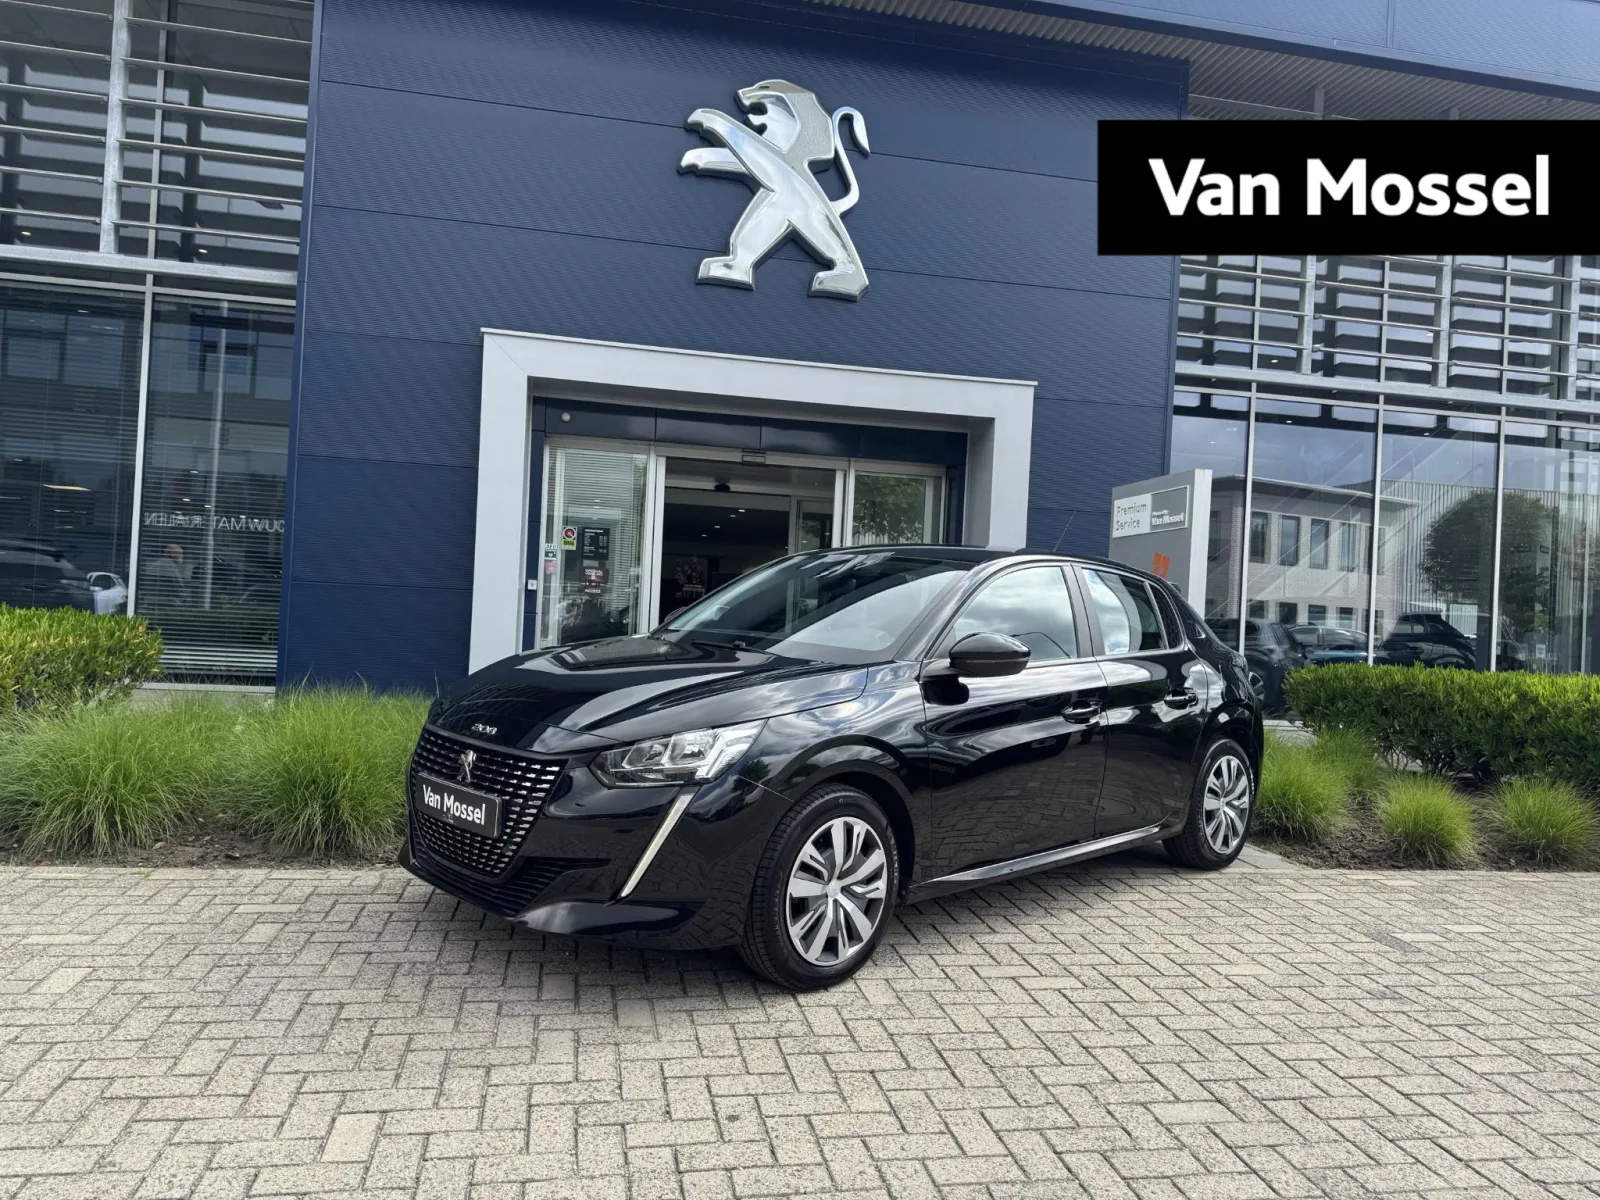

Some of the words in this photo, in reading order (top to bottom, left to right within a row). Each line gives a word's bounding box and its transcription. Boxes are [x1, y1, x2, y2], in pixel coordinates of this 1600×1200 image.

[1116, 502, 1147, 516] Premium
[1115, 517, 1140, 531] Service
[423, 784, 441, 810] Van
[443, 792, 486, 826] Mossel
